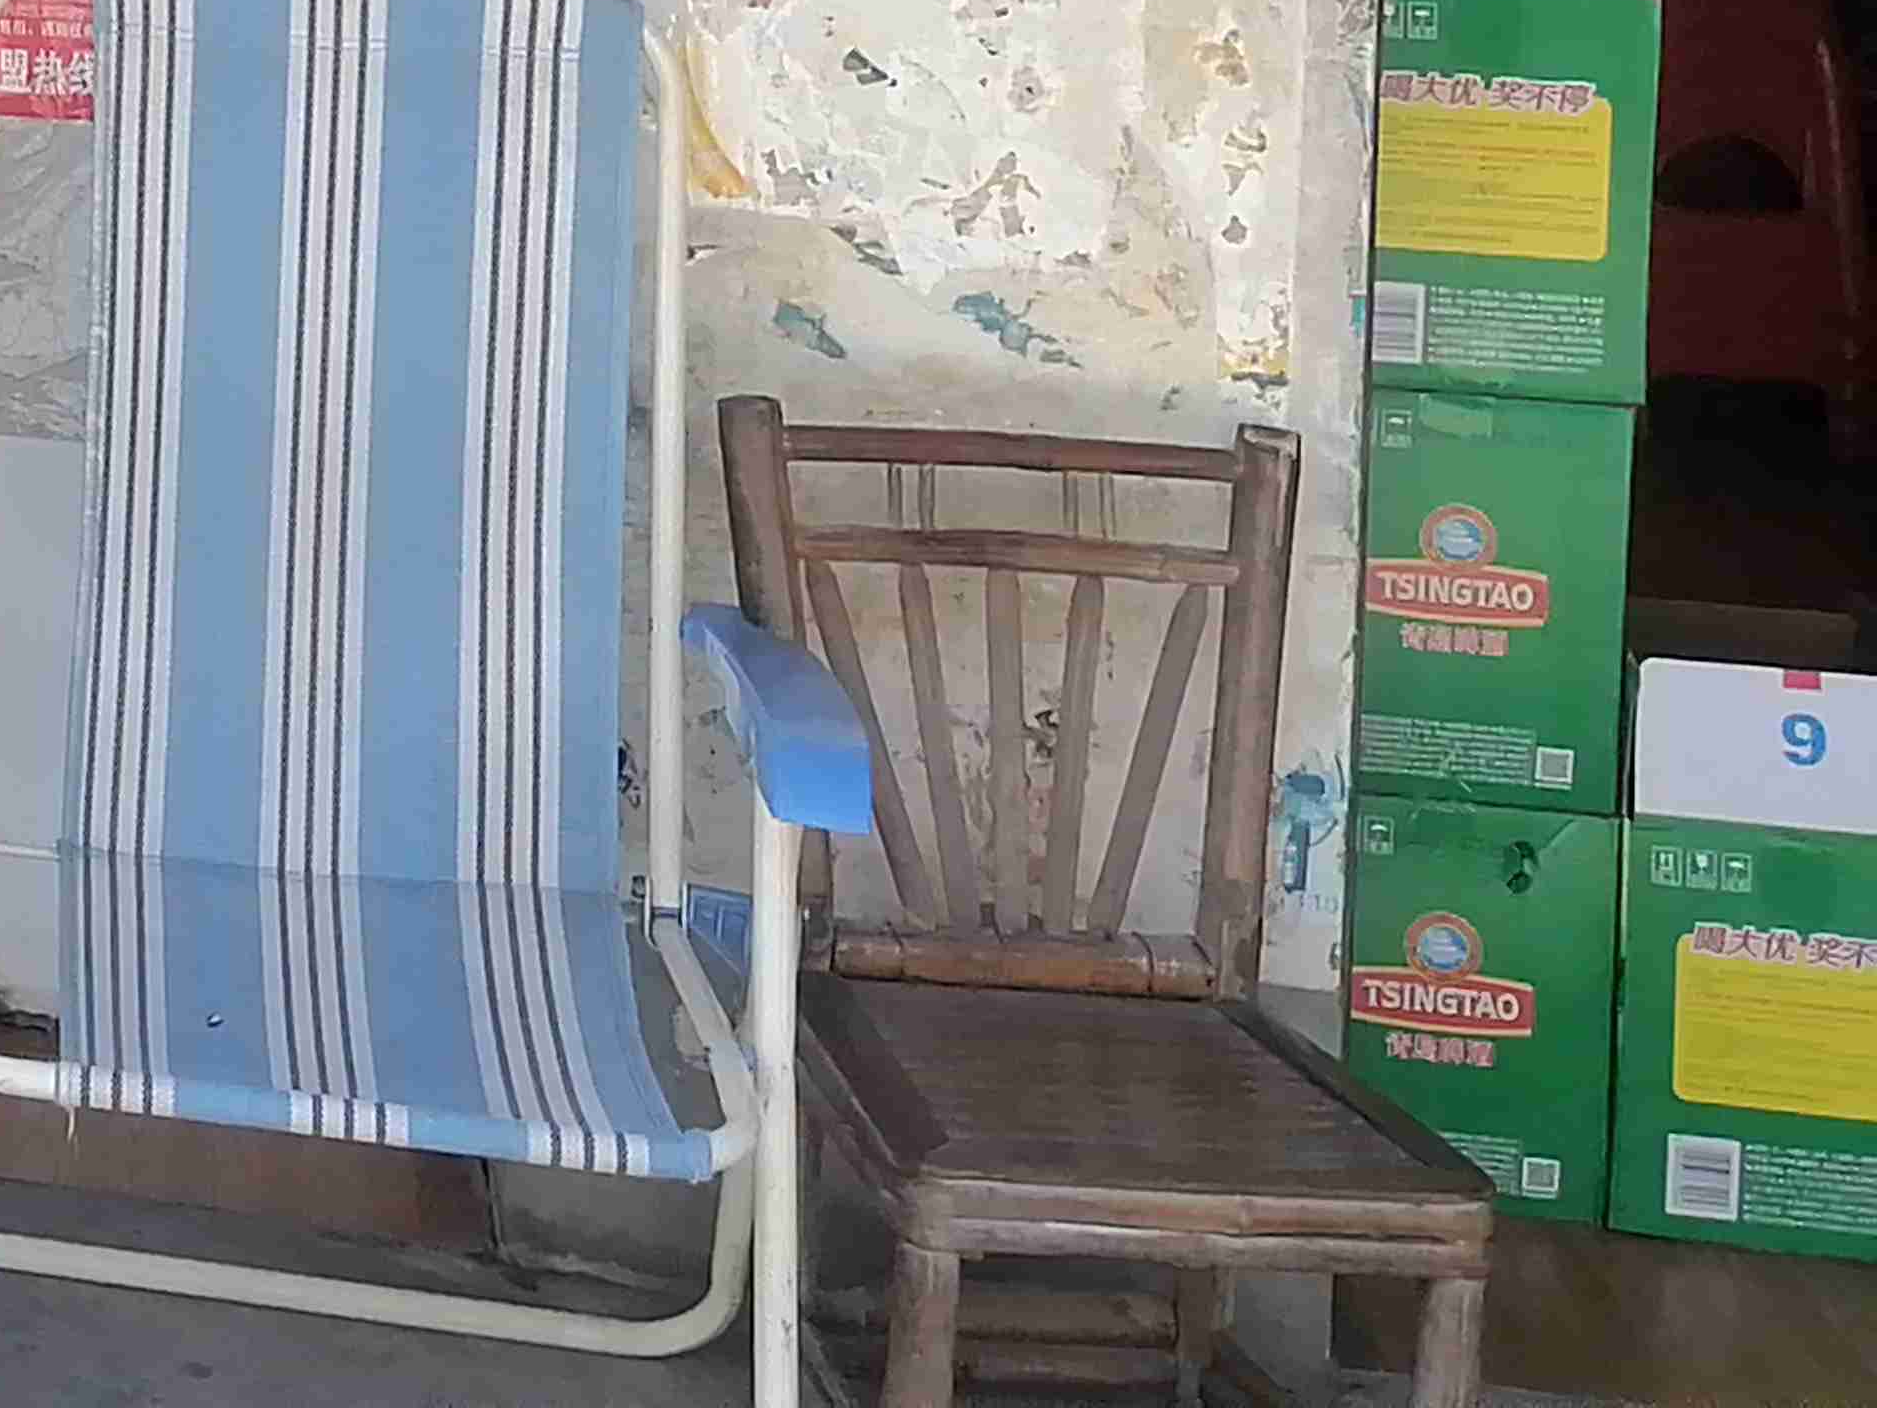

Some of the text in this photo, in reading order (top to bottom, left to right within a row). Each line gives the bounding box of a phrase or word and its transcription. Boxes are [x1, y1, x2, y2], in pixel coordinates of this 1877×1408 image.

[1376, 570, 1536, 614] TSINGTAO
[1781, 713, 1828, 767] 9
[1361, 978, 1522, 1023] TSINGTAO
